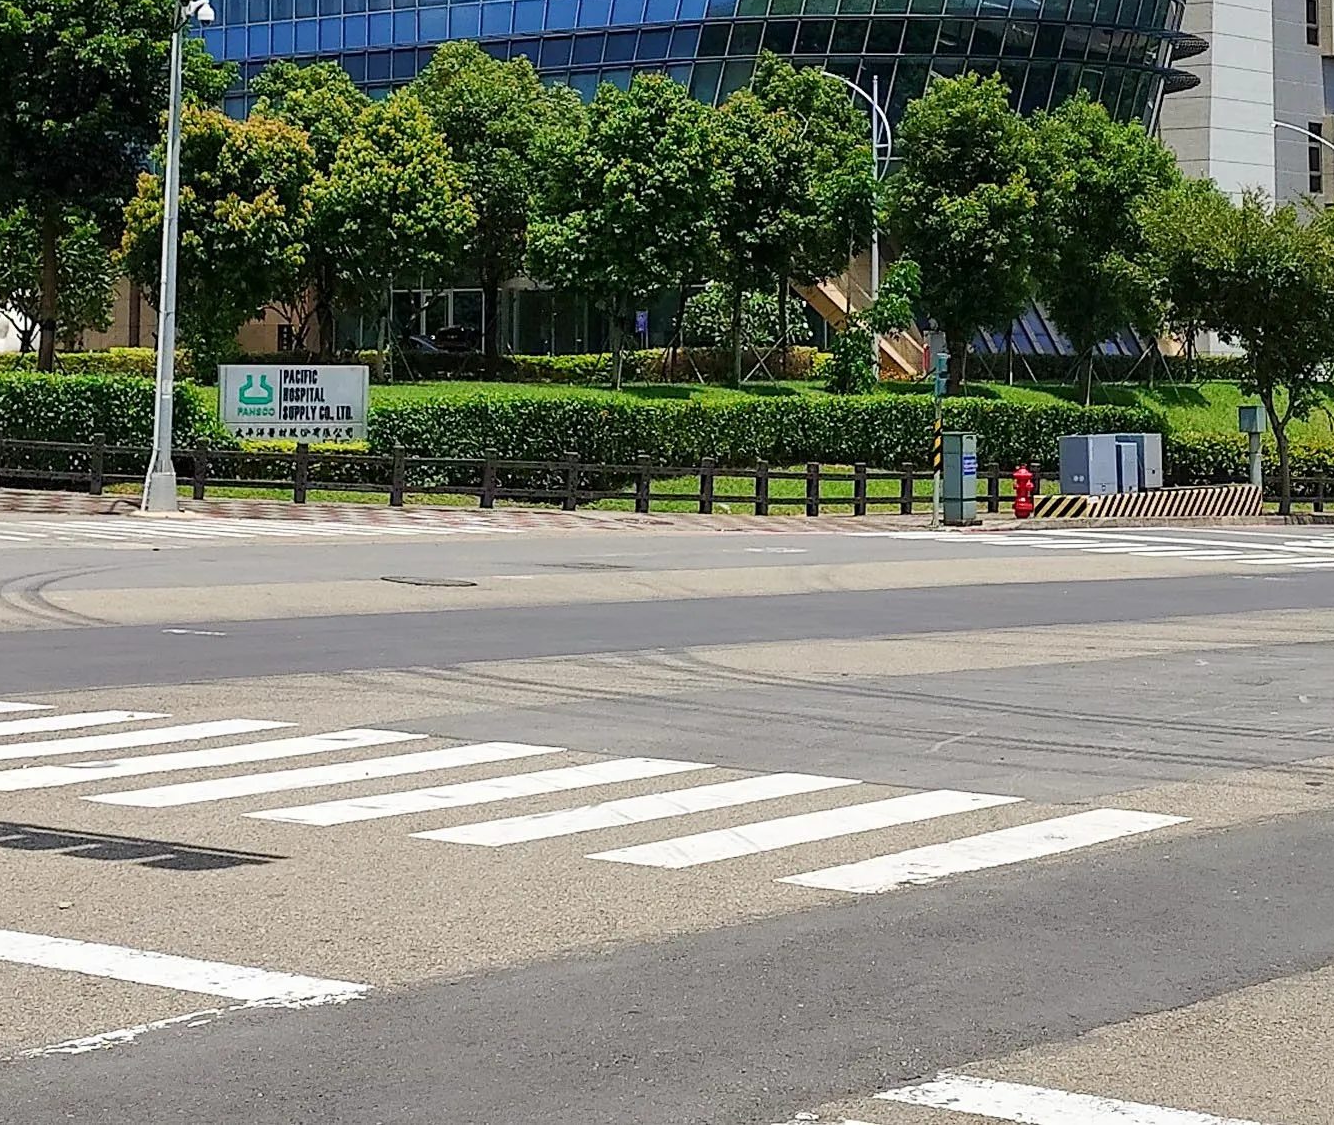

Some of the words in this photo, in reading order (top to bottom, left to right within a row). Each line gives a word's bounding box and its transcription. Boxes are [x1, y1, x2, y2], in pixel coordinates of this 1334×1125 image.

[283, 369, 318, 385] PACIFIC
[282, 387, 326, 403] HOSPITAL
[237, 407, 276, 417] PAHSCO
[282, 405, 317, 421] SUPPLY
[336, 405, 354, 421] LTD.
